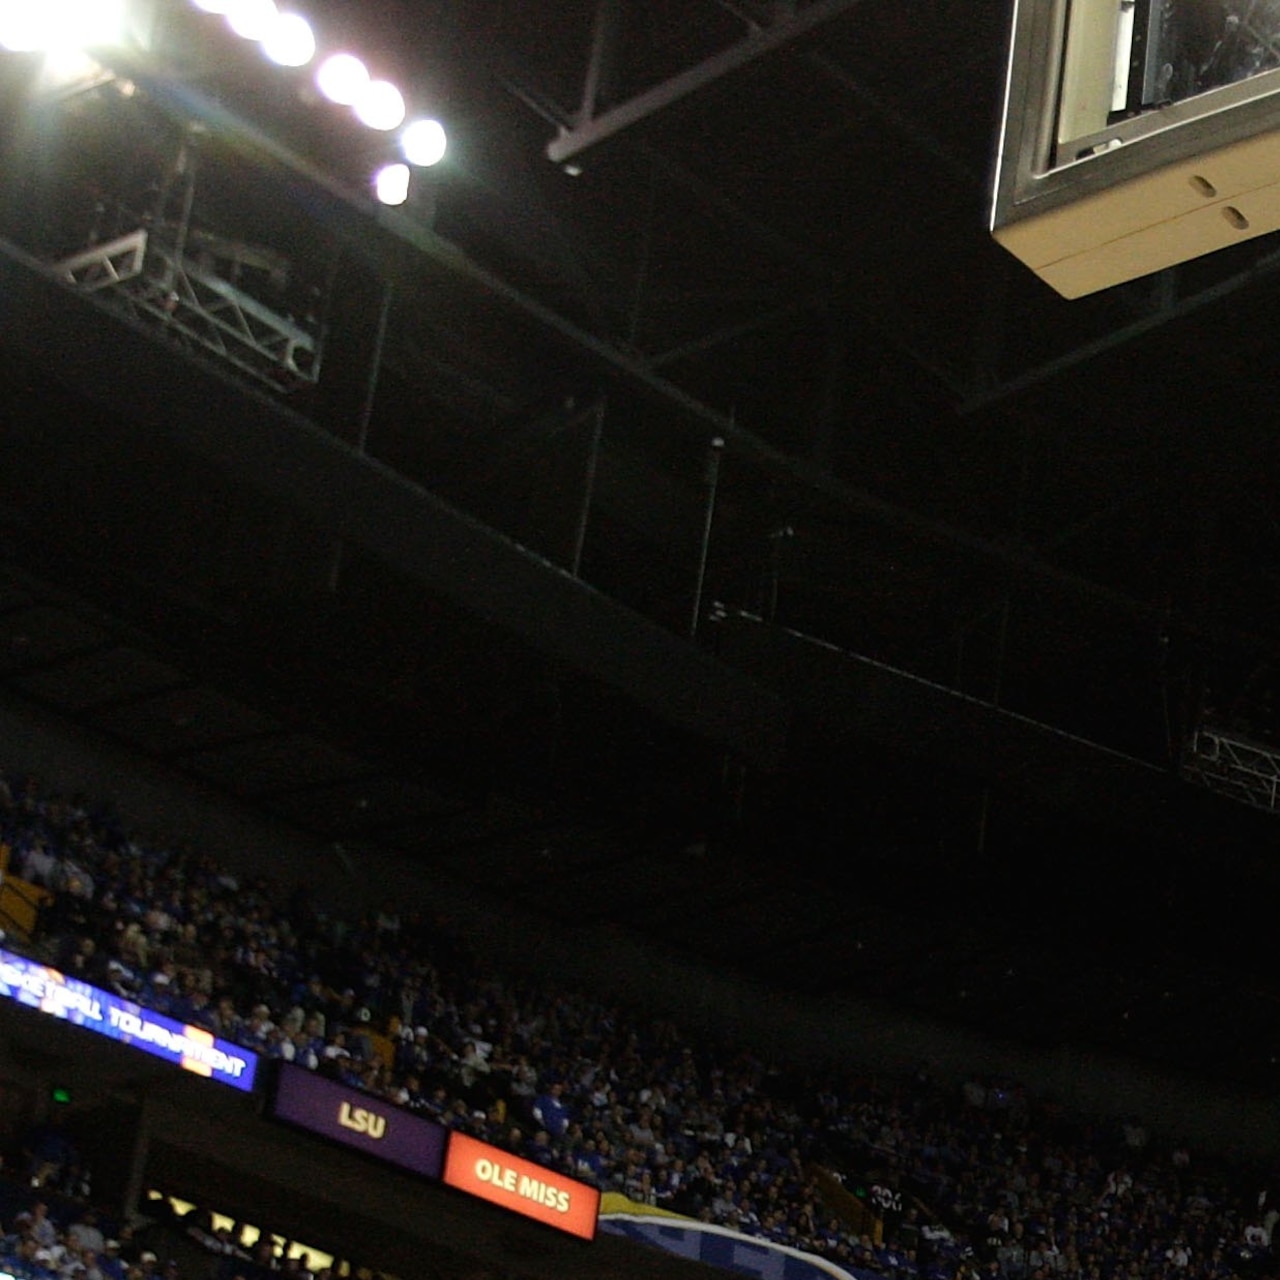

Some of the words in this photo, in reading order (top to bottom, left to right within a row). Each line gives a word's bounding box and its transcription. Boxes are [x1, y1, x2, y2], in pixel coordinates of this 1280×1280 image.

[108, 1005, 246, 1077] TOURNAMENT
[338, 1101, 386, 1140] LSU
[474, 1158, 517, 1194] OLE
[519, 1172, 571, 1213] MISS
